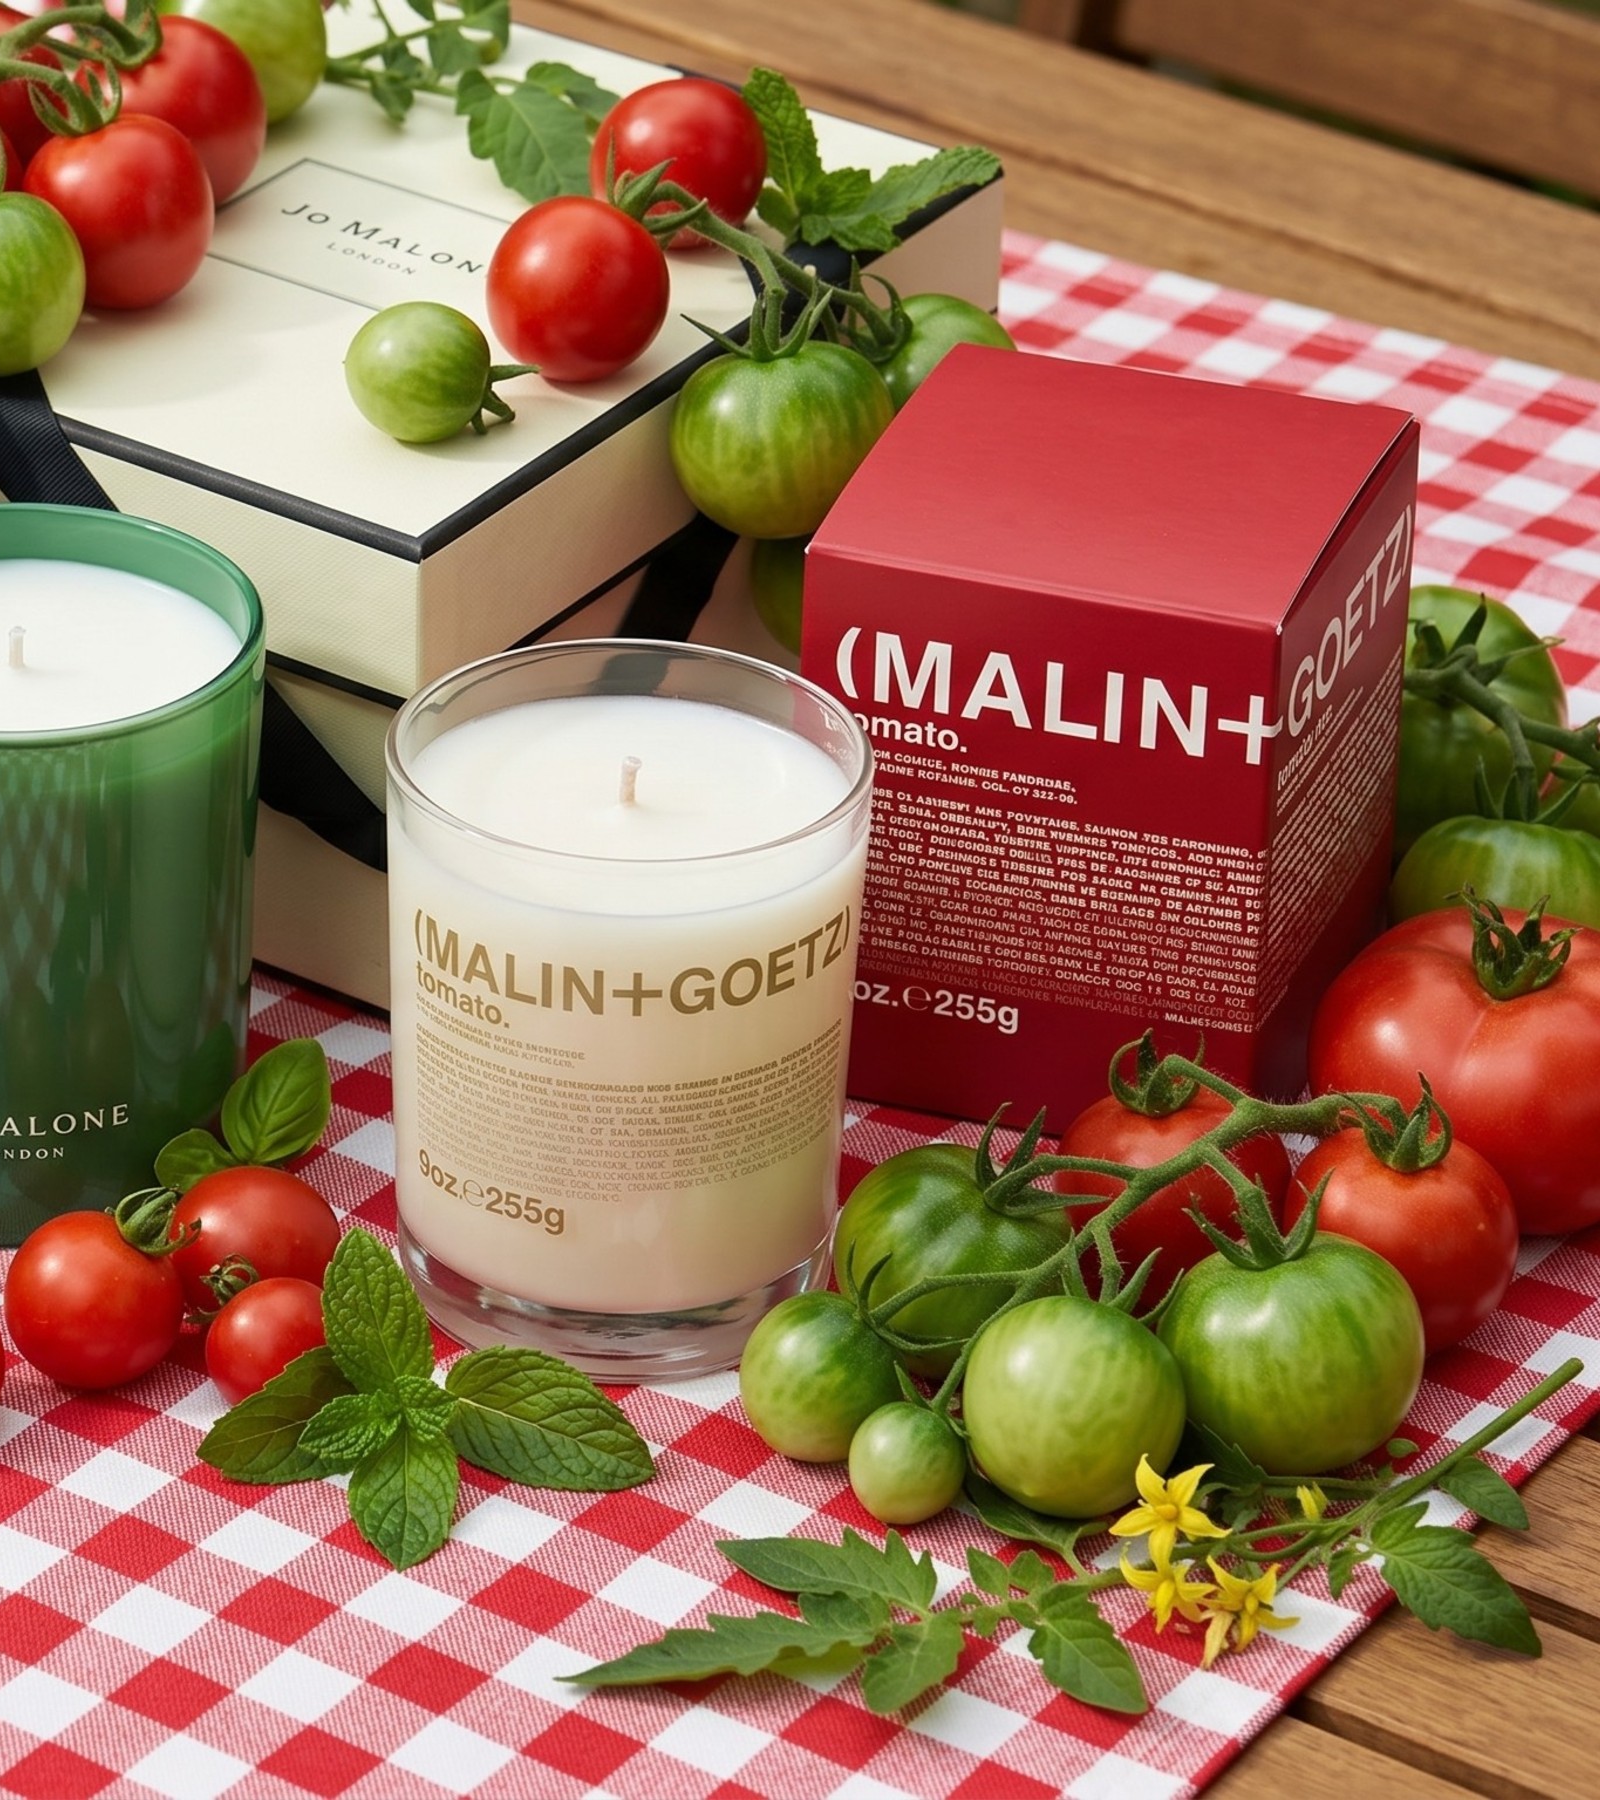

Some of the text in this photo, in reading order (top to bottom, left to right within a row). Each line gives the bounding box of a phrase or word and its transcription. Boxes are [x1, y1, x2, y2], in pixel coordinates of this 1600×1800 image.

[327, 242, 418, 276] LONDON
[340, 220, 485, 275] MALON
[853, 712, 968, 753] omato.
[414, 905, 851, 1017] (MALIN+GOETZ)
[416, 959, 511, 1029] tomato.
